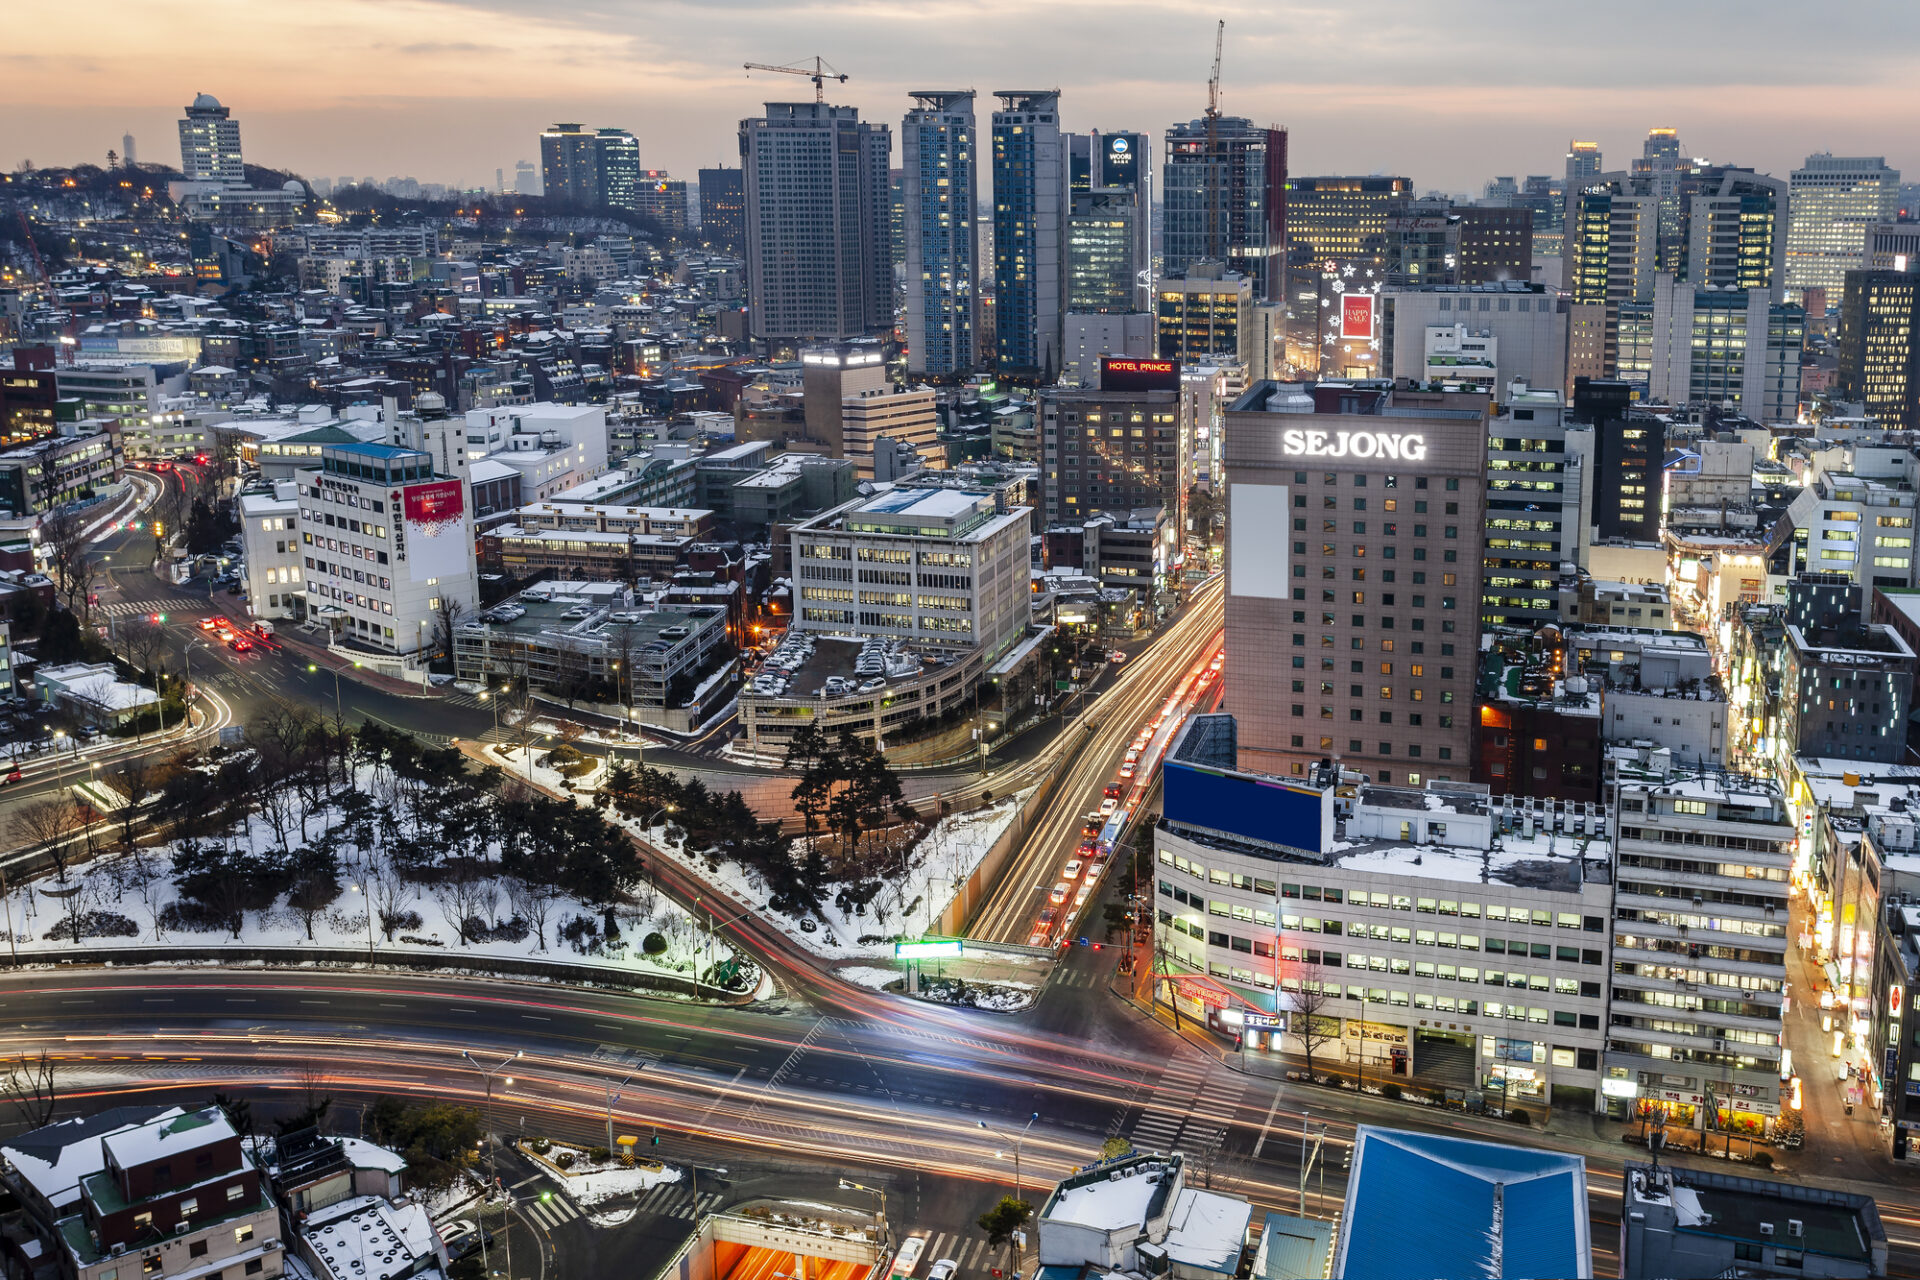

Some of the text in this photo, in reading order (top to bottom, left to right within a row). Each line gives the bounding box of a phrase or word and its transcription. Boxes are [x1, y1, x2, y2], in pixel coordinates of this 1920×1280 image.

[1395, 219, 1438, 232] Migliore
[1109, 362, 1172, 372] HOTEL PRINCE
[1284, 429, 1426, 460] SEJONG
[324, 479, 359, 495] 대한적십자사
[392, 503, 406, 562] 대한적십자사
